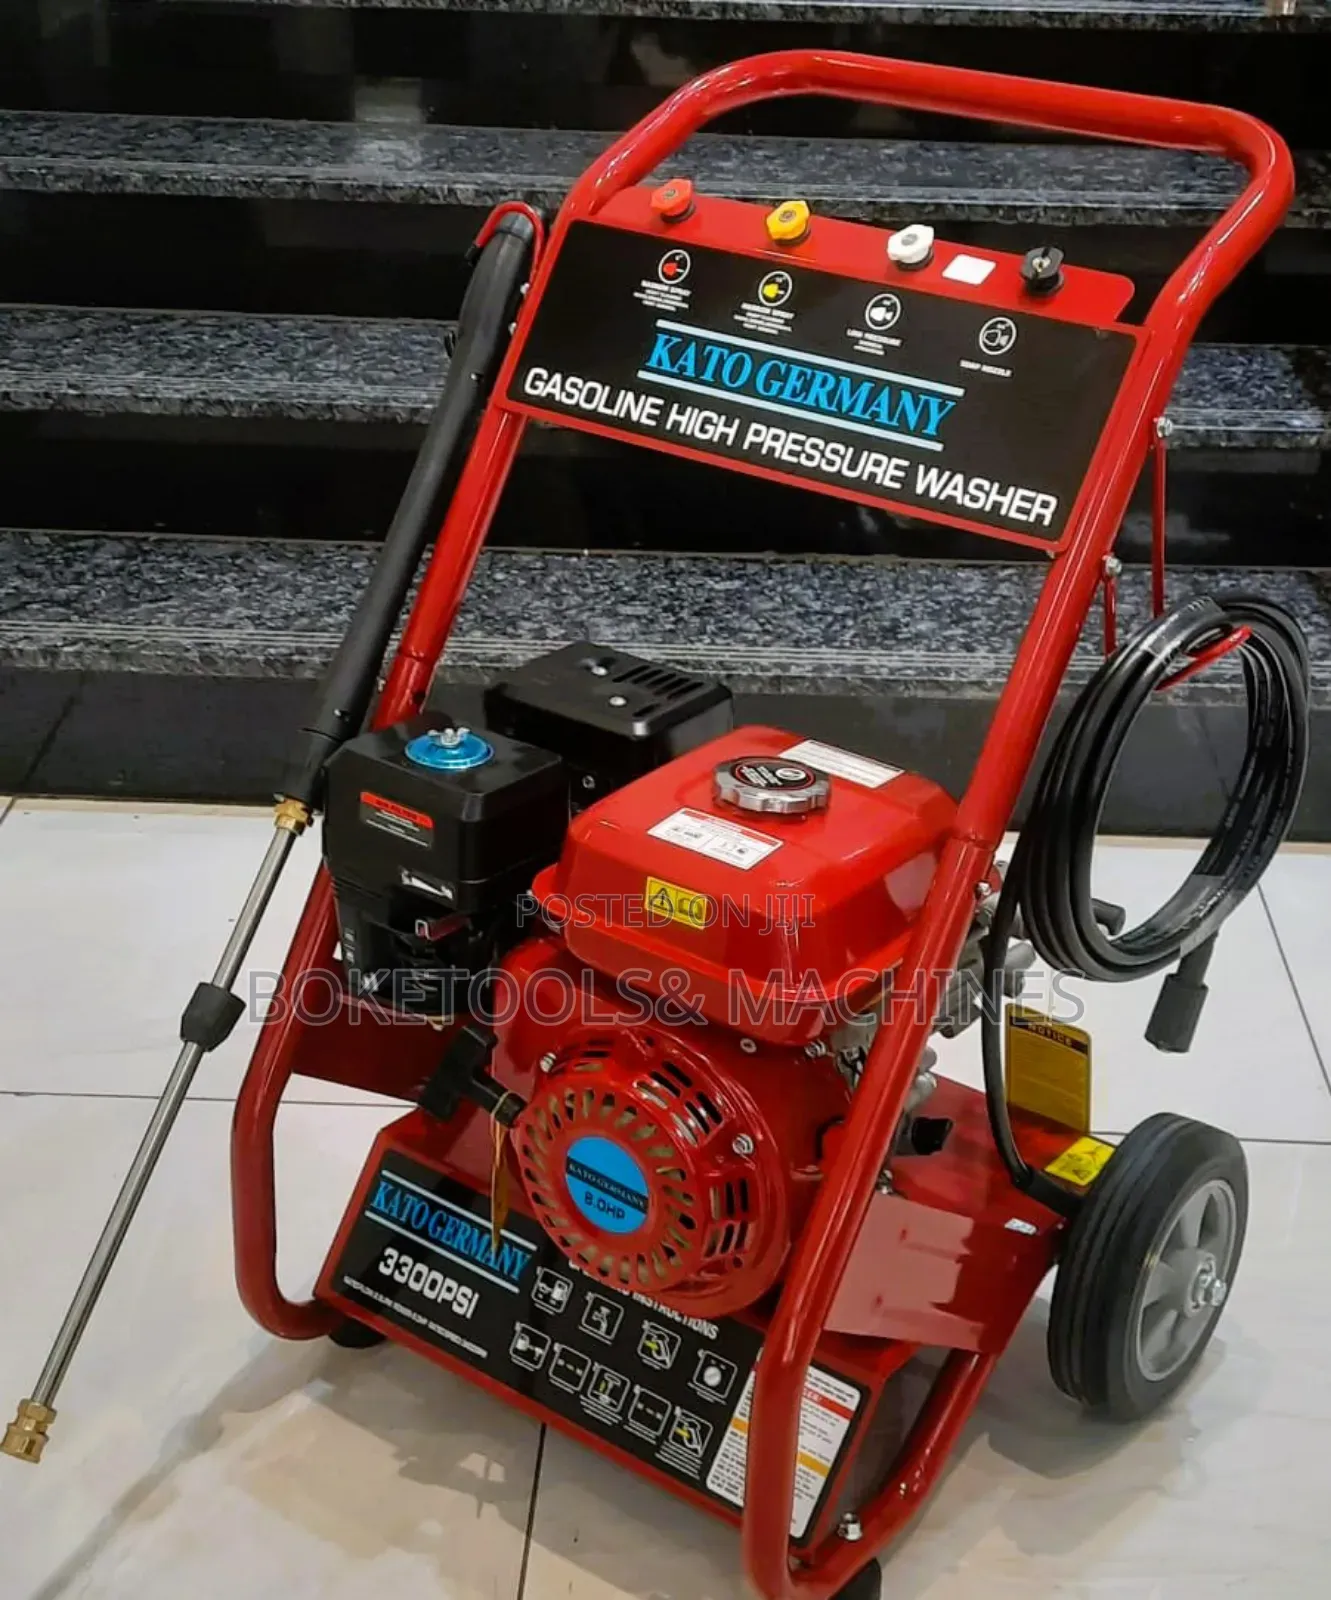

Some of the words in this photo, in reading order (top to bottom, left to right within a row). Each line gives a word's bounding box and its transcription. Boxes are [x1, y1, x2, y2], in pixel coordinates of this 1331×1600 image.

[646, 333, 752, 388] KATO
[755, 359, 956, 436] GERMANY
[523, 367, 665, 427] GASOLINE
[665, 403, 741, 447] HIGH
[743, 422, 911, 490] PRESSURE
[915, 463, 1059, 527] WASHER
[370, 1180, 430, 1231] KATO
[428, 1209, 532, 1281] GERMANY
[378, 1246, 480, 1320] 3300PSI
